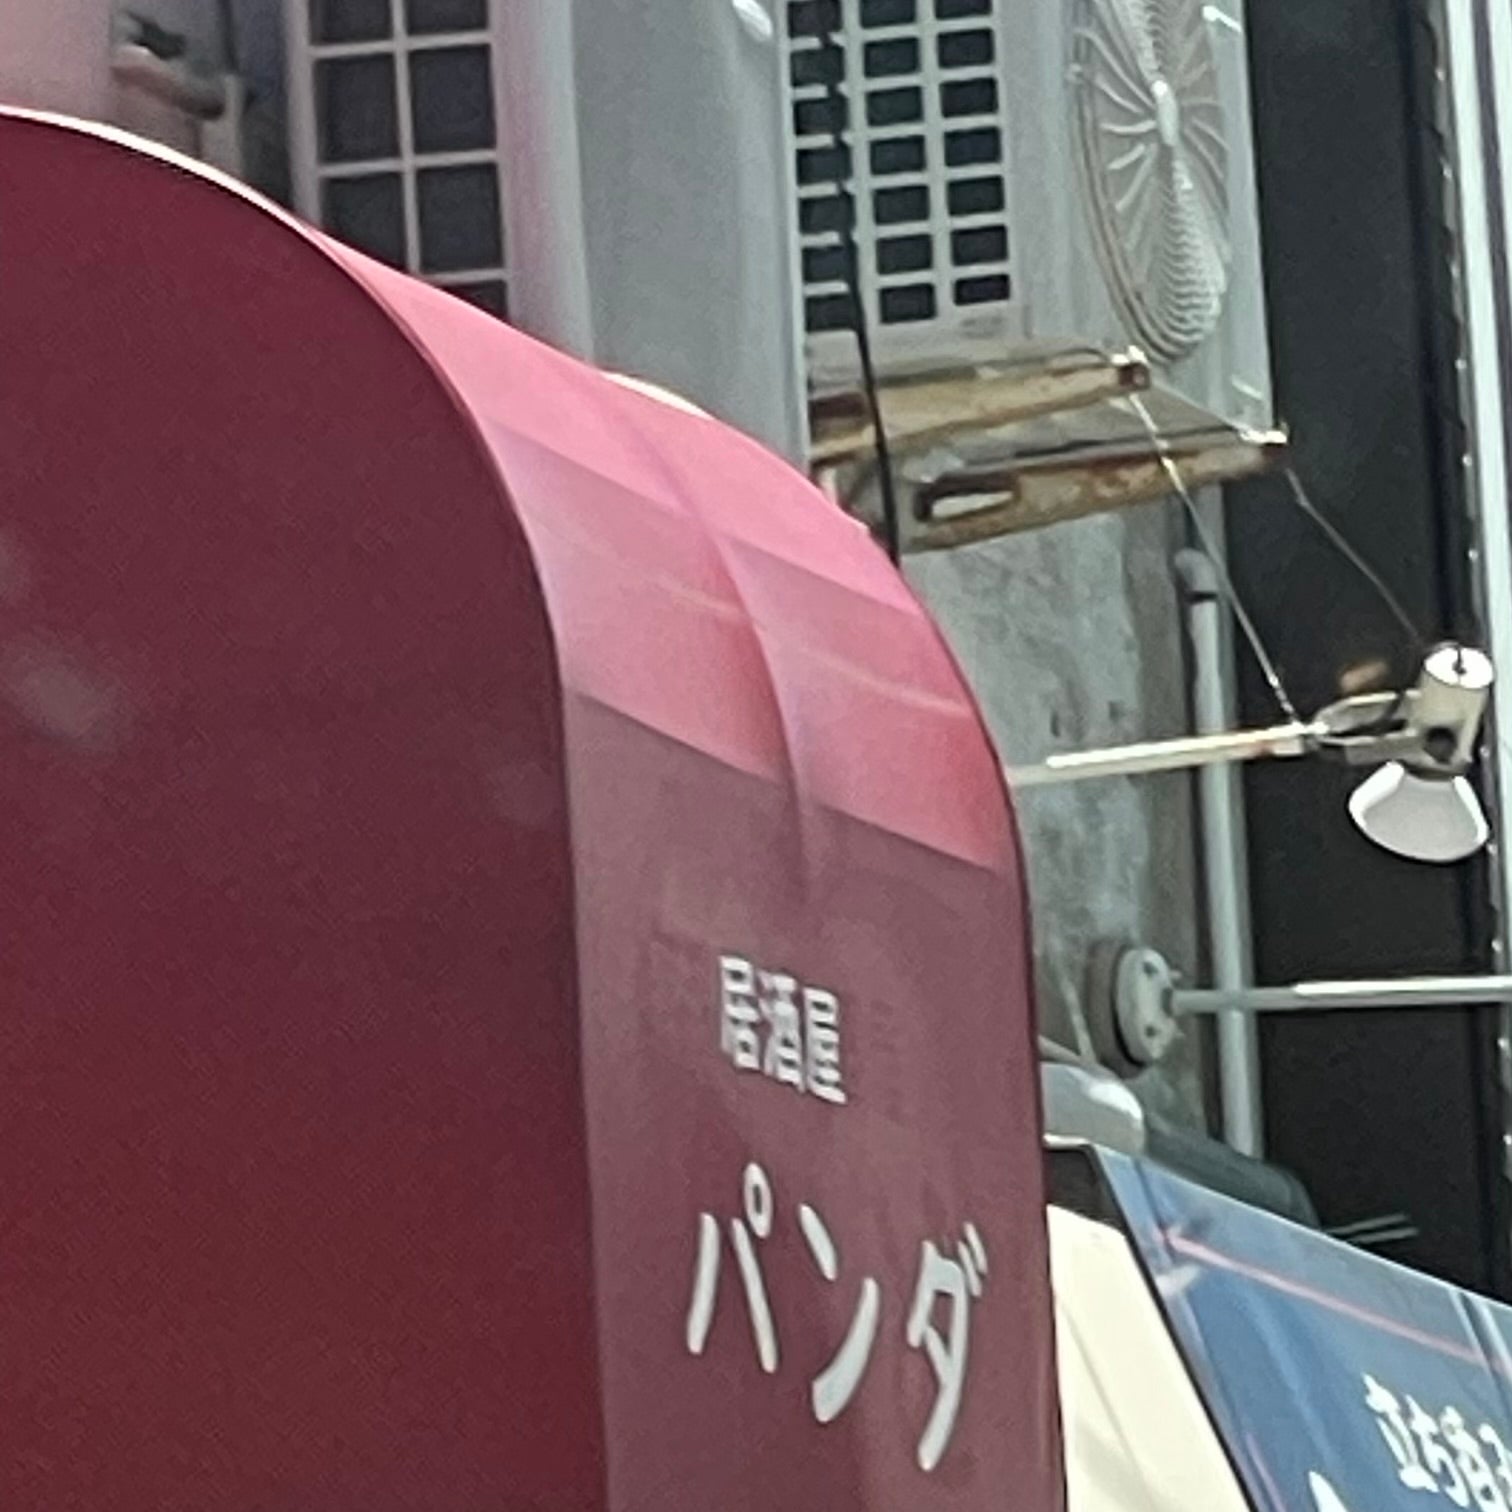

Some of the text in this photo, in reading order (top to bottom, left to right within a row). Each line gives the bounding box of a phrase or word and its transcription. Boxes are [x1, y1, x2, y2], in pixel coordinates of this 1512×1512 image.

[718, 954, 848, 1105] 居酒屋
[686, 1161, 989, 1472] パンダ
